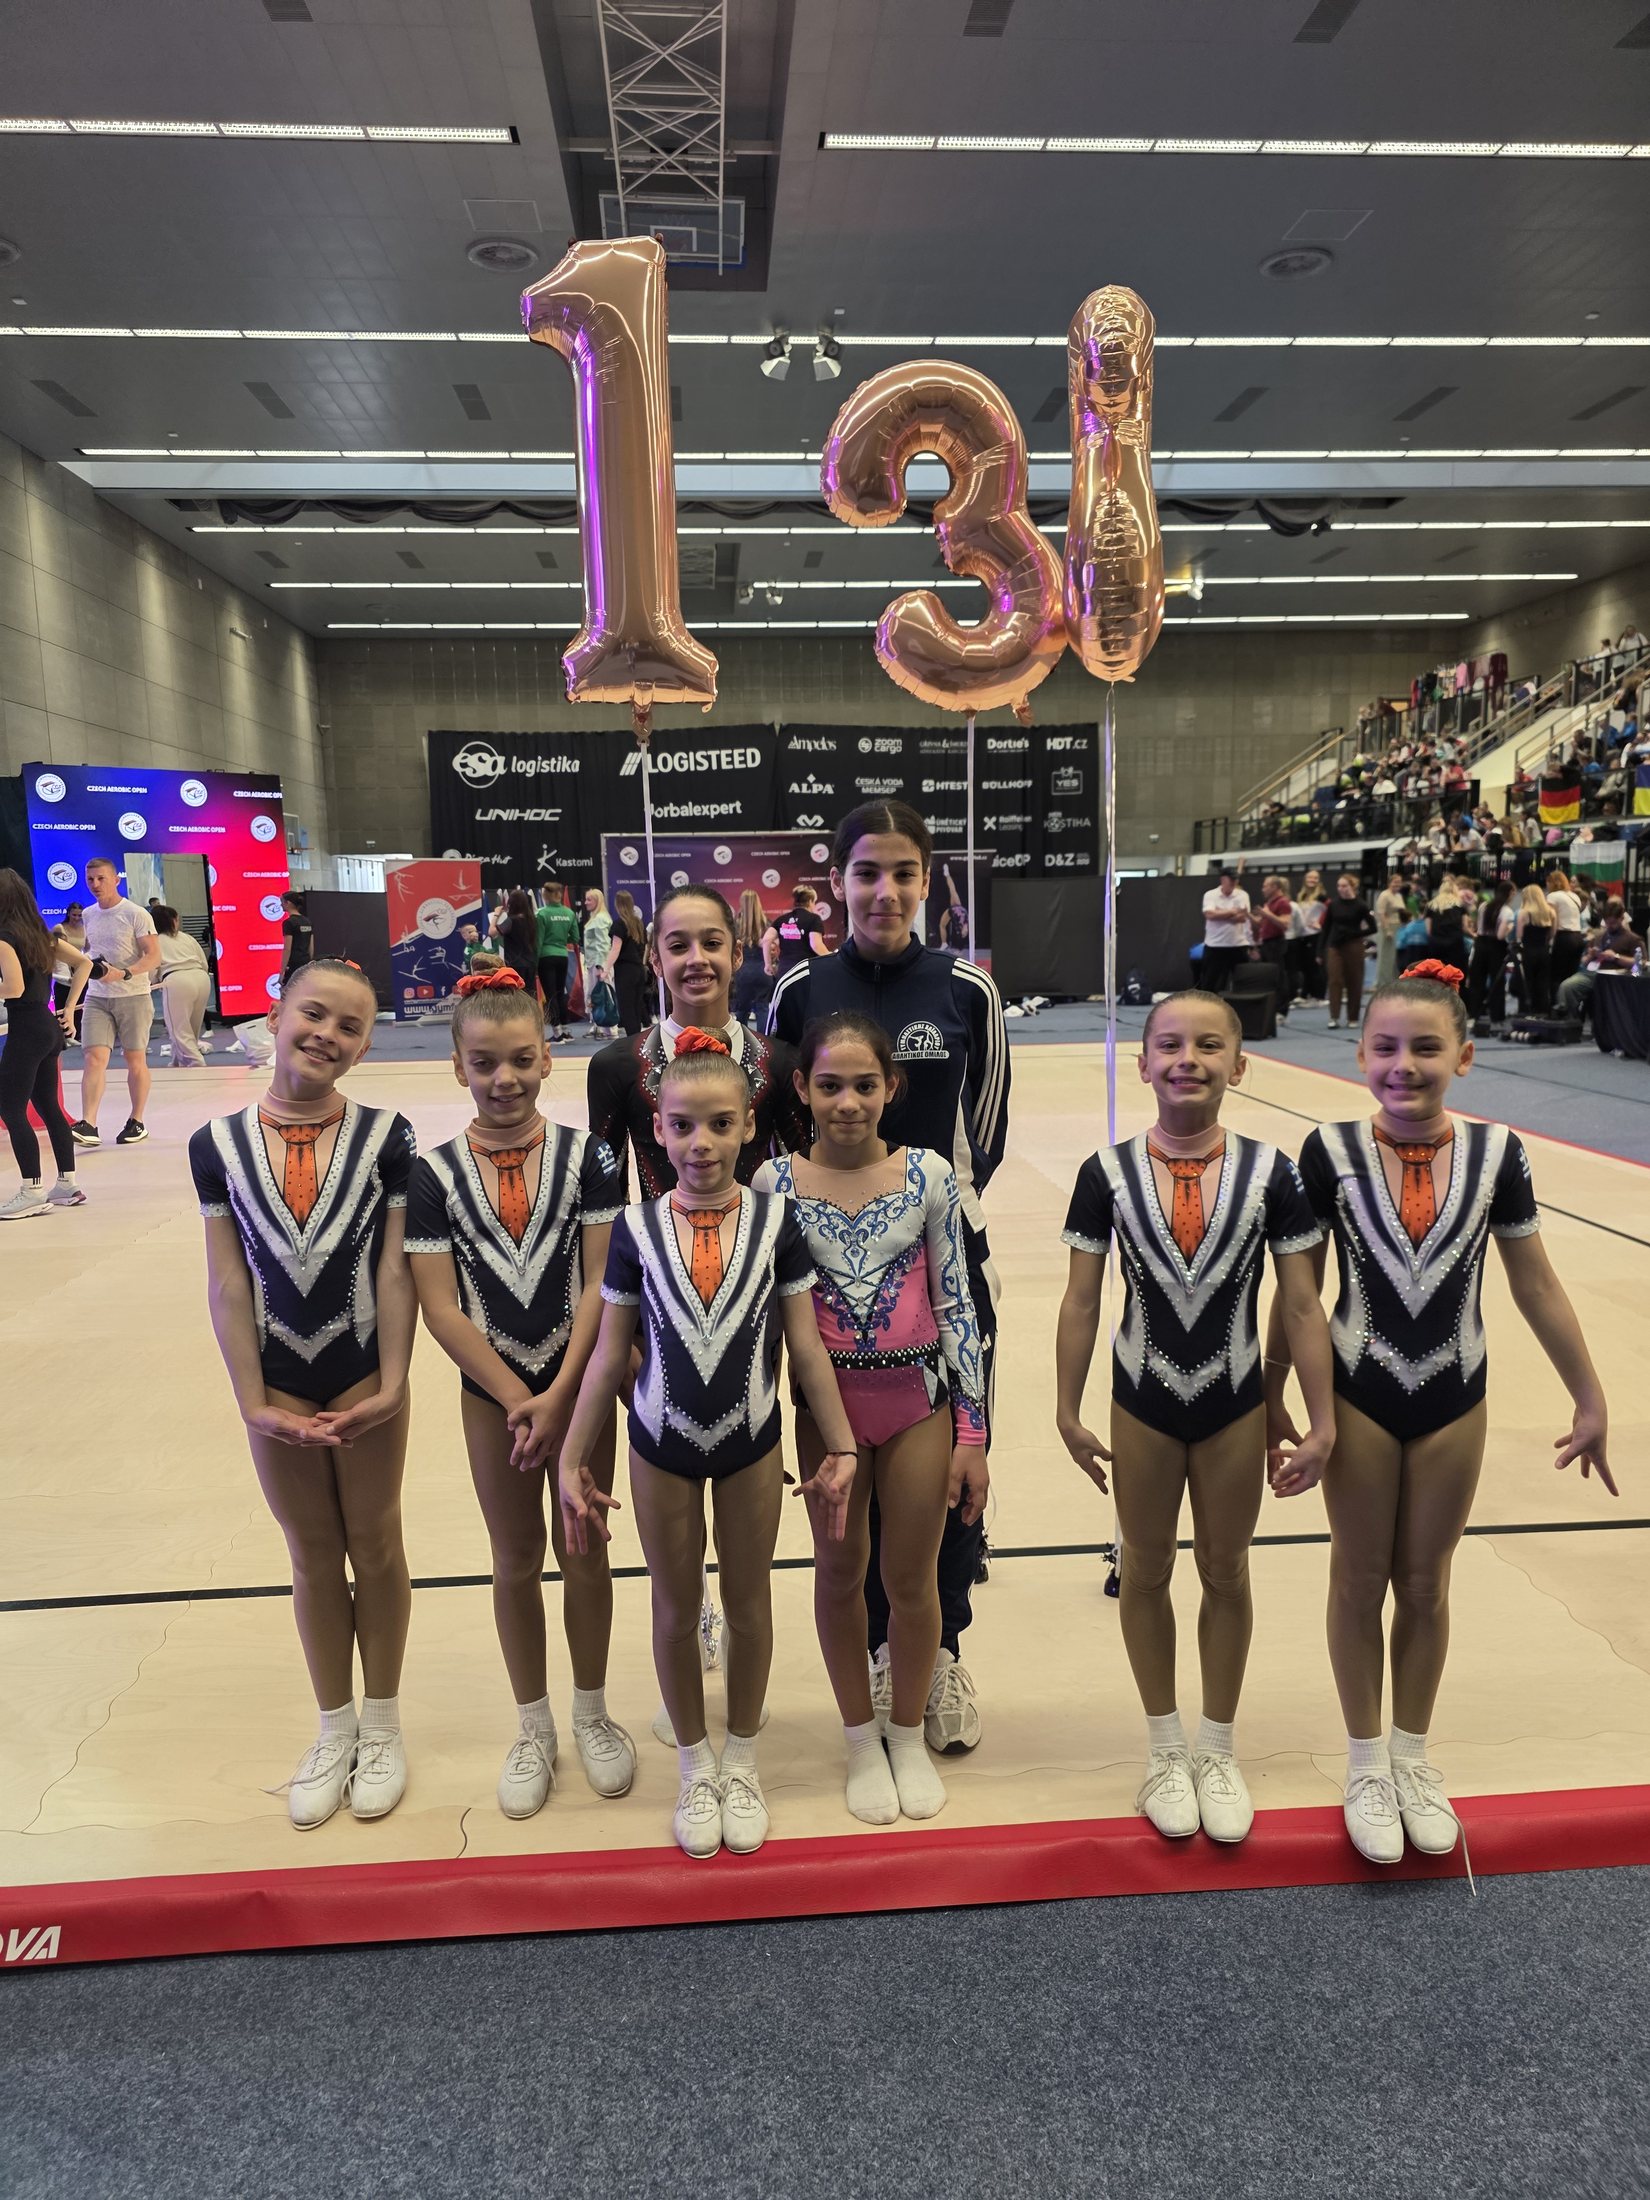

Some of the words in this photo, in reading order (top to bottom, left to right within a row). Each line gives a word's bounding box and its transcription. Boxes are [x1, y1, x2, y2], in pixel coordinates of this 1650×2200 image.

[521, 234, 719, 704] 1
[874, 737, 902, 746] zoom
[874, 744, 902, 755] cargo
[511, 755, 580, 778] logistika
[647, 747, 761, 774] LOGISTEED
[788, 782, 834, 794] ALPA
[882, 778, 904, 786] VODA
[936, 781, 968, 790] HTEST
[1056, 778, 1079, 787] YES
[475, 808, 562, 821] UNIHOC
[644, 800, 742, 819] lorbalexpert
[556, 857, 593, 867] Kastomi
[1045, 853, 1075, 867] D&Z
[0, 1925, 62, 1962] VA
